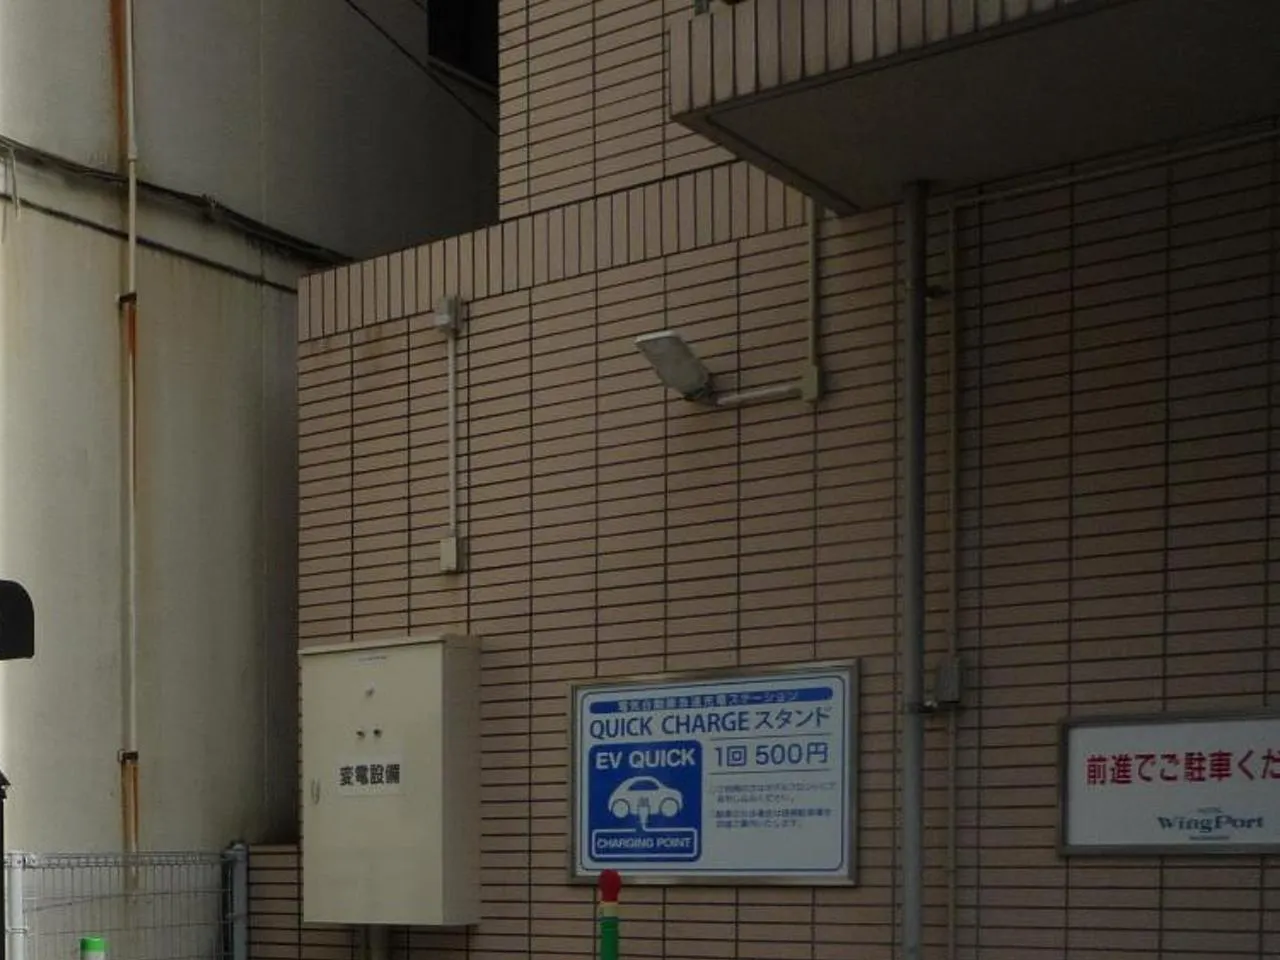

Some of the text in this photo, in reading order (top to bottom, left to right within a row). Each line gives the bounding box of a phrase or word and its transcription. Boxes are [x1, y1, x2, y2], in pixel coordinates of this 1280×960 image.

[589, 706, 832, 740] QUICK CHARGE スタンド
[595, 747, 697, 770] EV QUICK
[755, 742, 829, 765] 500円
[596, 836, 692, 849] CHARGING POINT
